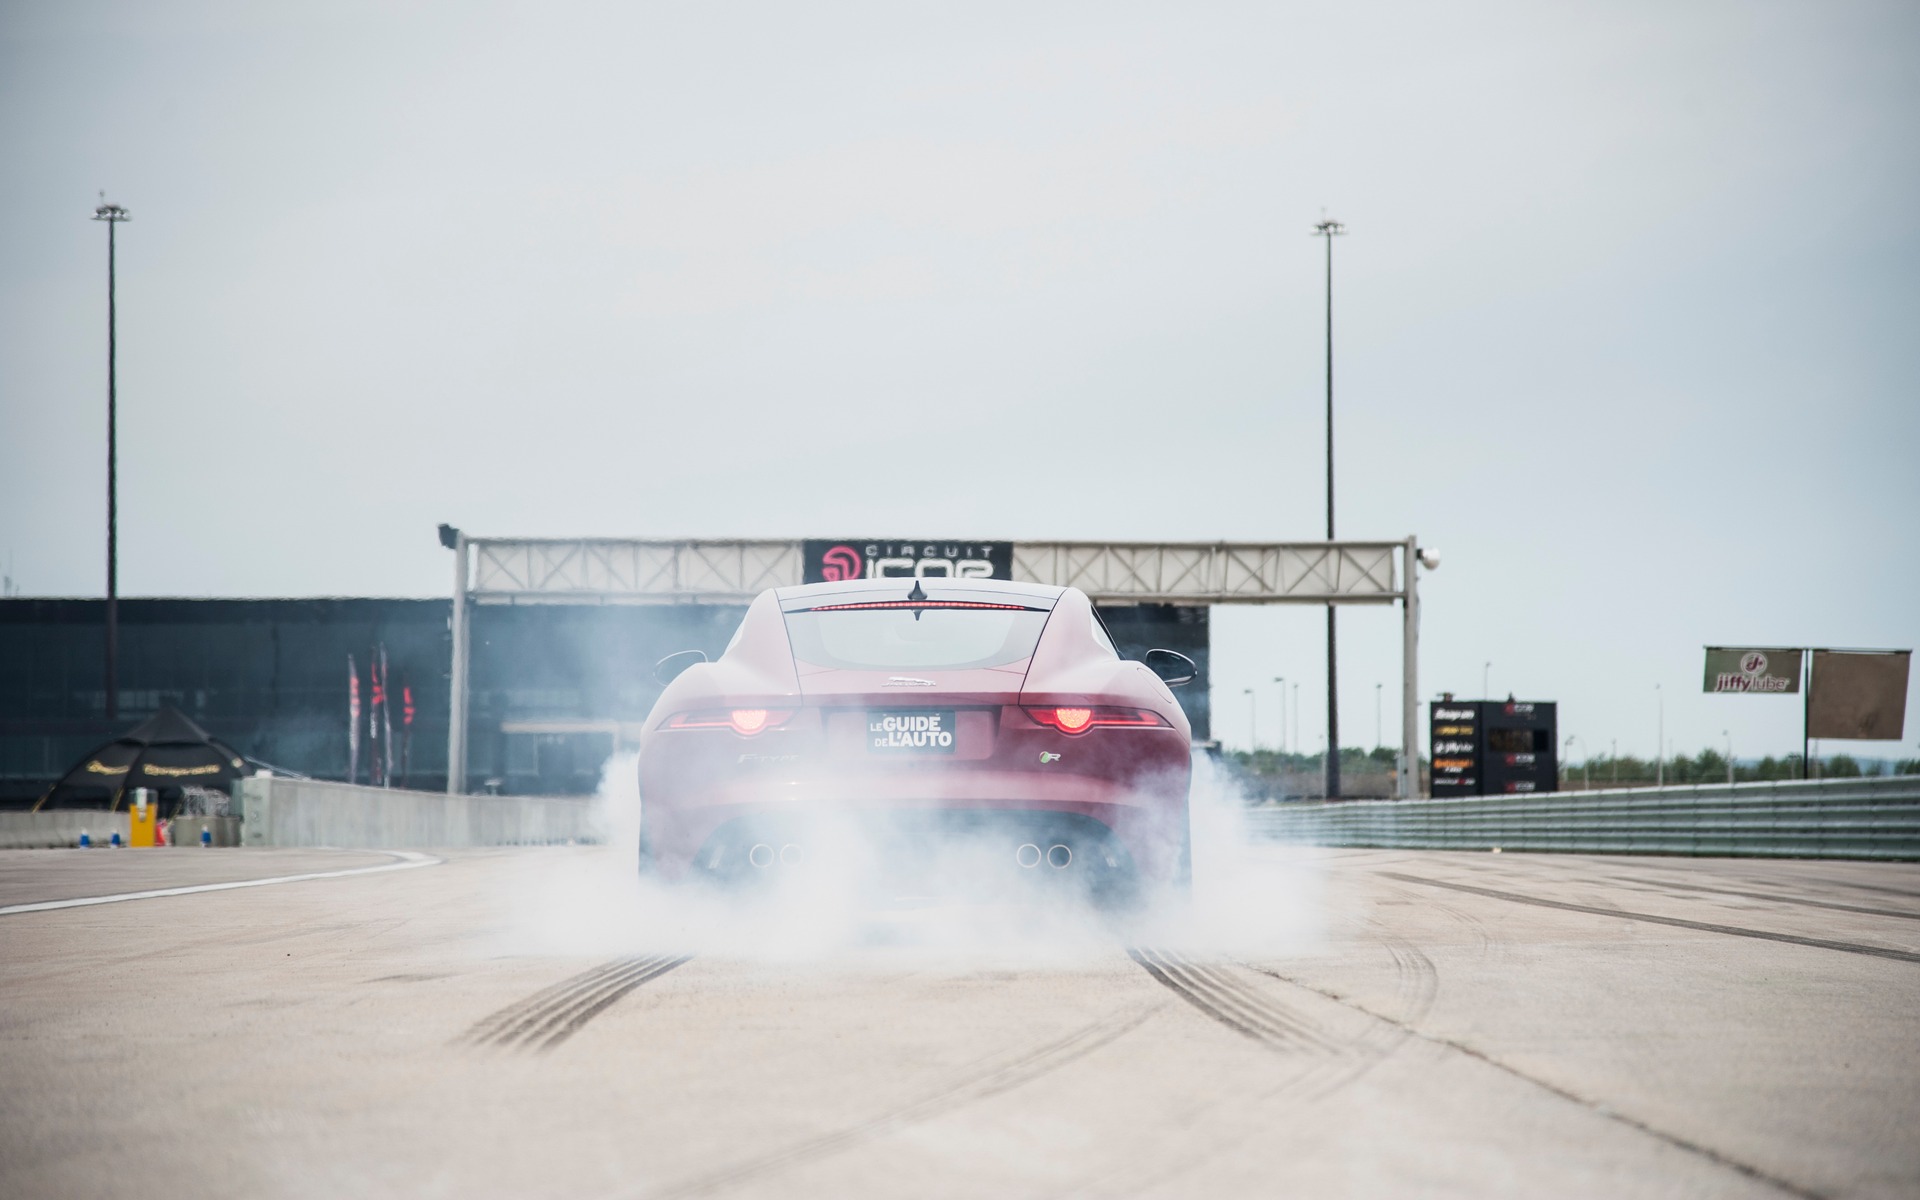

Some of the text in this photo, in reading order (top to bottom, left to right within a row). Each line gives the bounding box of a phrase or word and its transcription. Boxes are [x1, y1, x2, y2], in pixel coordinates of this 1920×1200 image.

[865, 544, 993, 558] CIRCUIT
[870, 716, 941, 732] LE GUIDE
[874, 731, 952, 747] DE L'AUTO
